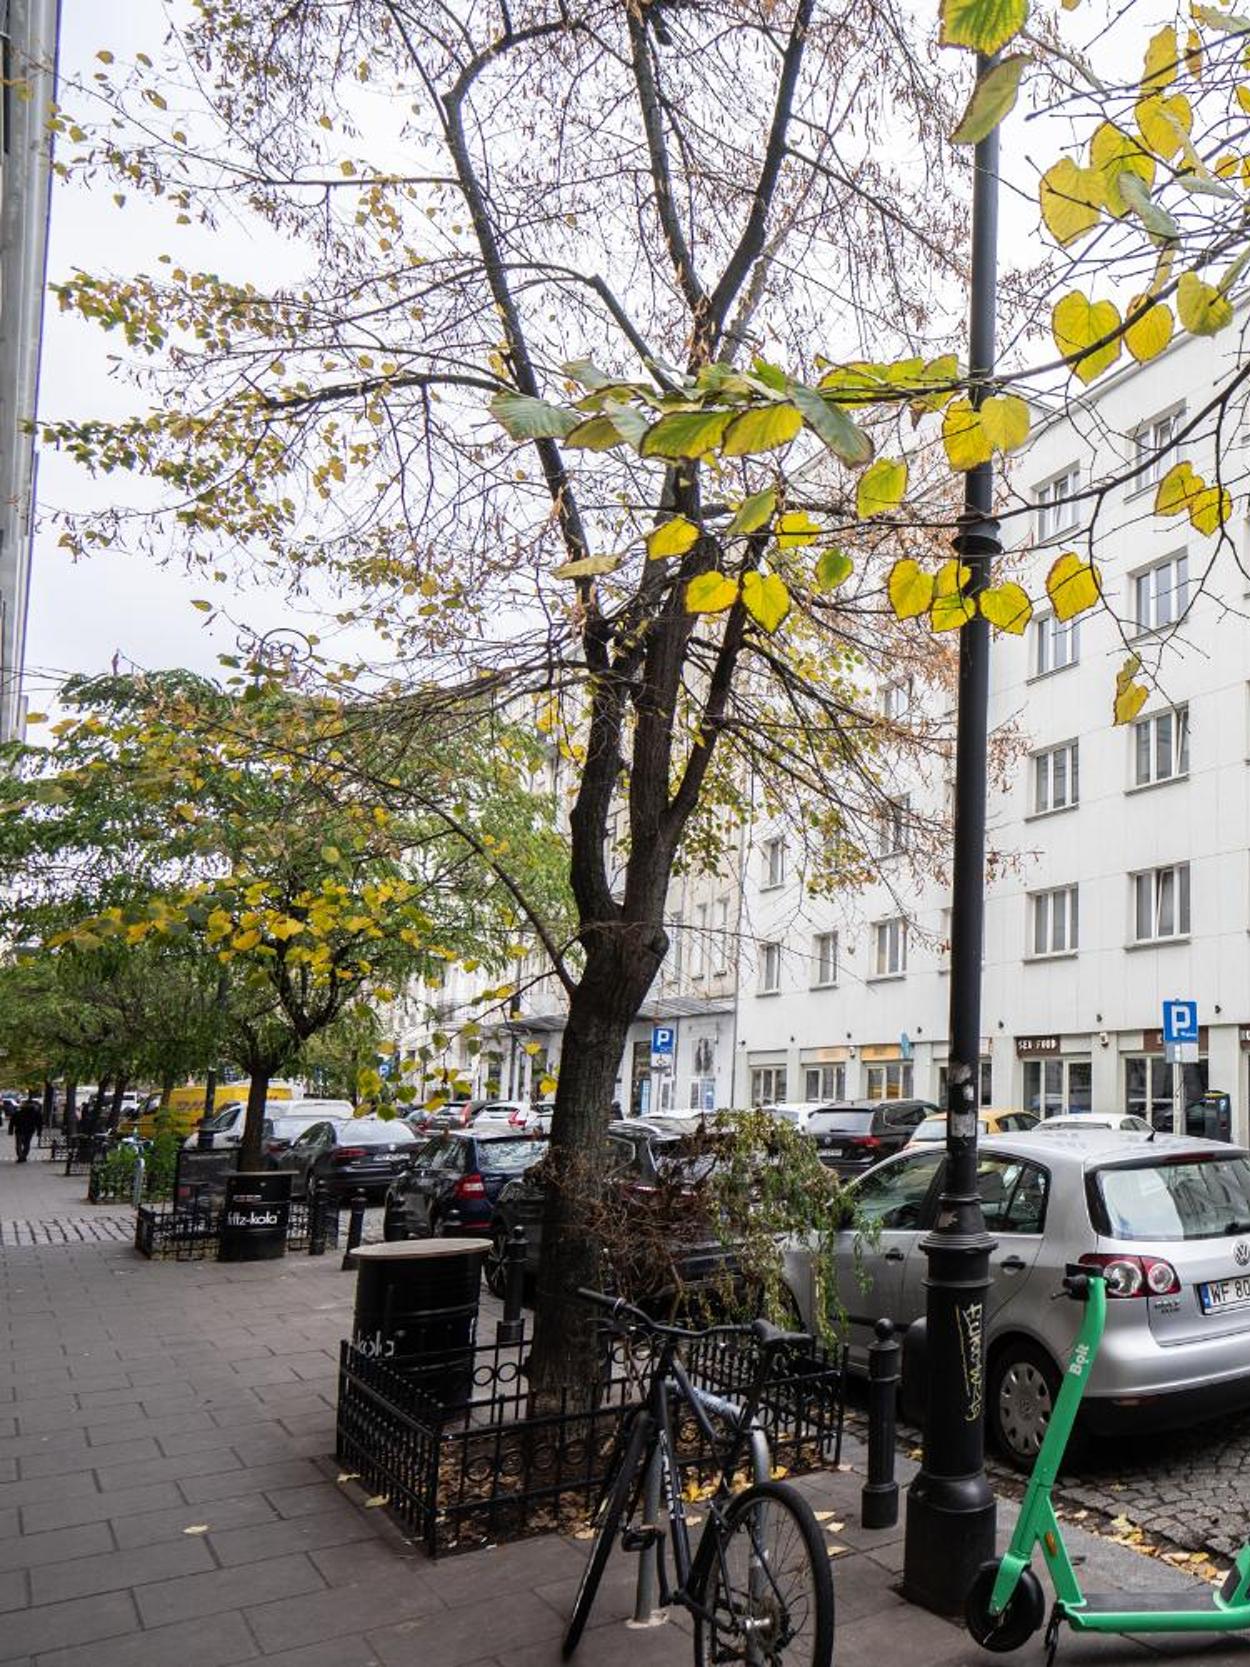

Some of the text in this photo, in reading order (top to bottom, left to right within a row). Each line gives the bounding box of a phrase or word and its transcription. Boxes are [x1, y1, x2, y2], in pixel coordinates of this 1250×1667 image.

[1171, 1006, 1191, 1037] P
[657, 1030, 669, 1046] P
[1210, 1281, 1229, 1304] WF
[1069, 1344, 1089, 1376] Bolt
